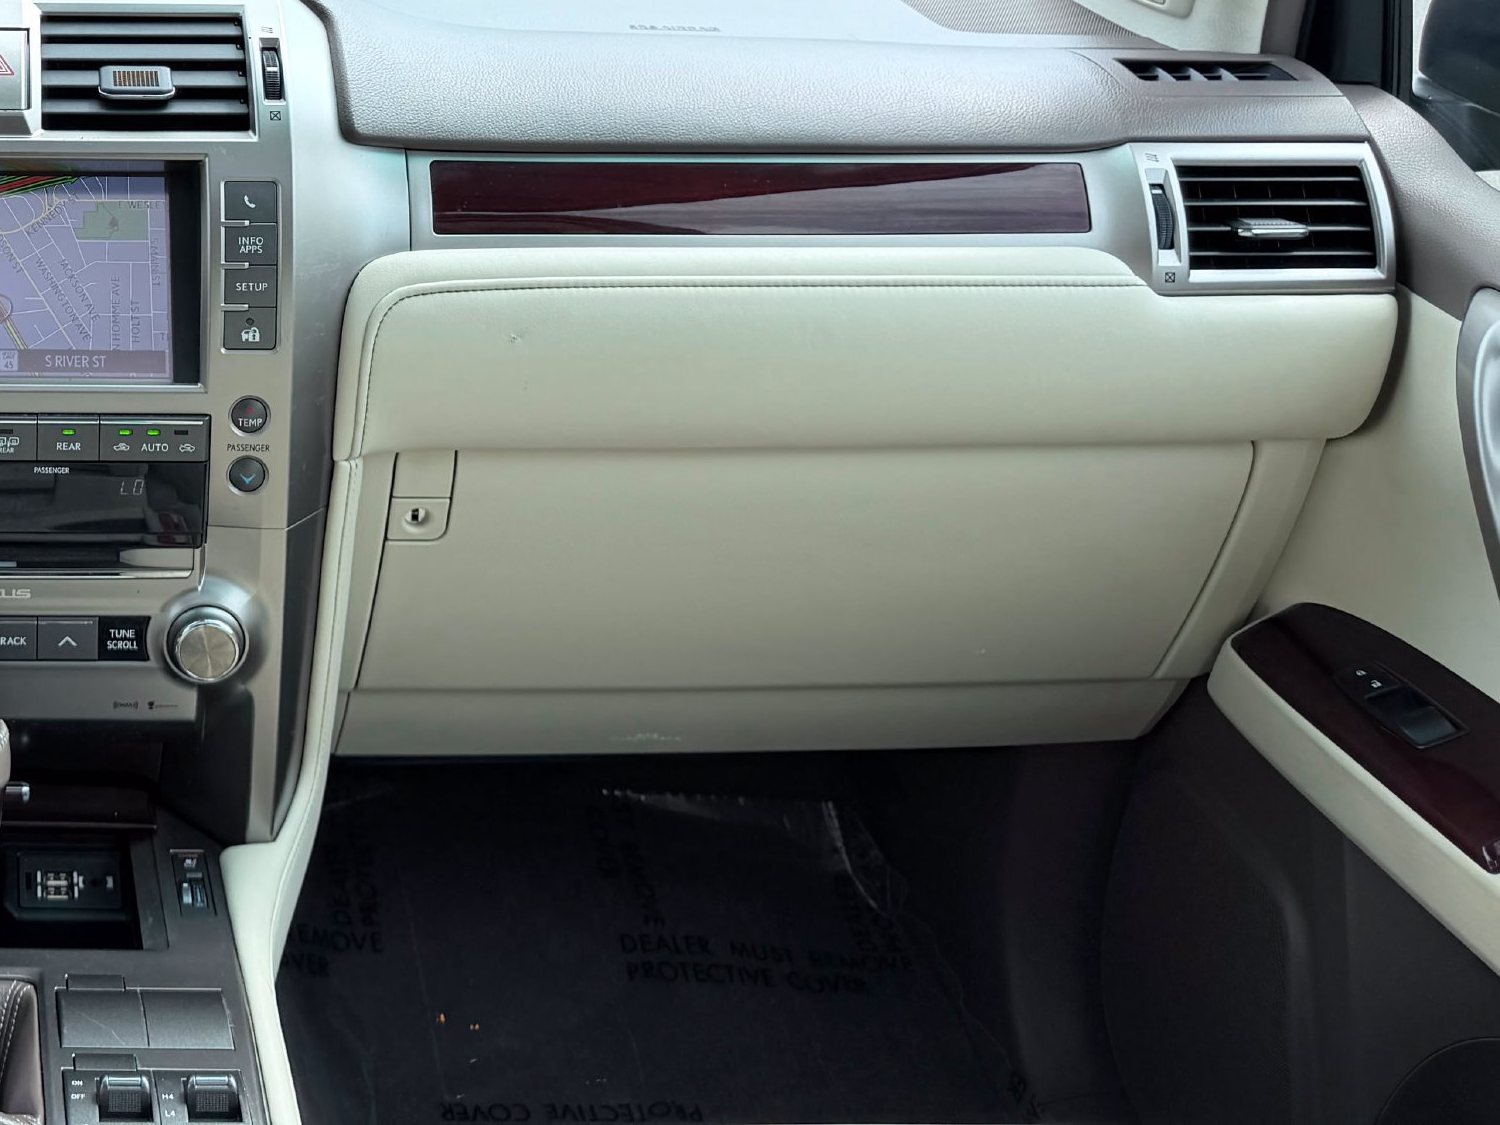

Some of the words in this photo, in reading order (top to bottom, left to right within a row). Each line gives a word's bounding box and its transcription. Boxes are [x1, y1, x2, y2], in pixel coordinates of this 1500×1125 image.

[25, 204, 68, 237] KENNEDY
[67, 193, 81, 205] ST
[238, 236, 264, 245] INFO
[239, 245, 263, 254] APPS
[150, 245, 161, 274] MAIN
[11, 260, 24, 275] ST
[110, 275, 120, 296] AVE
[151, 274, 161, 287] ST
[235, 282, 268, 292] SETUP
[58, 257, 89, 304] JACKSON
[84, 301, 101, 323] AVE
[35, 257, 78, 324] WASHINGTON
[74, 321, 92, 343] AVE
[130, 299, 140, 314] ST
[131, 316, 141, 344] HOLT
[4, 361, 14, 370] 45
[44, 355, 52, 367] S
[55, 355, 90, 368] RIVER
[92, 355, 107, 368] ST
[237, 418, 263, 428] TEMP
[56, 442, 82, 451] REAR
[141, 443, 169, 453] AUTO
[226, 443, 270, 453] PASSENGER
[33, 466, 70, 475] PASSENGER
[108, 628, 136, 639] TUNE
[106, 639, 138, 650] SCROLL
[618, 931, 712, 955] DEALER
[729, 939, 794, 965] MUST
[807, 949, 915, 974] REMOVE
[625, 960, 780, 987] PROTECTIVE
[786, 971, 870, 994] COVER
[161, 1093, 174, 1101] H4
[164, 1110, 176, 1118] L4
[440, 1102, 532, 1123] COVER
[543, 1099, 704, 1124] PROTECTIVE
